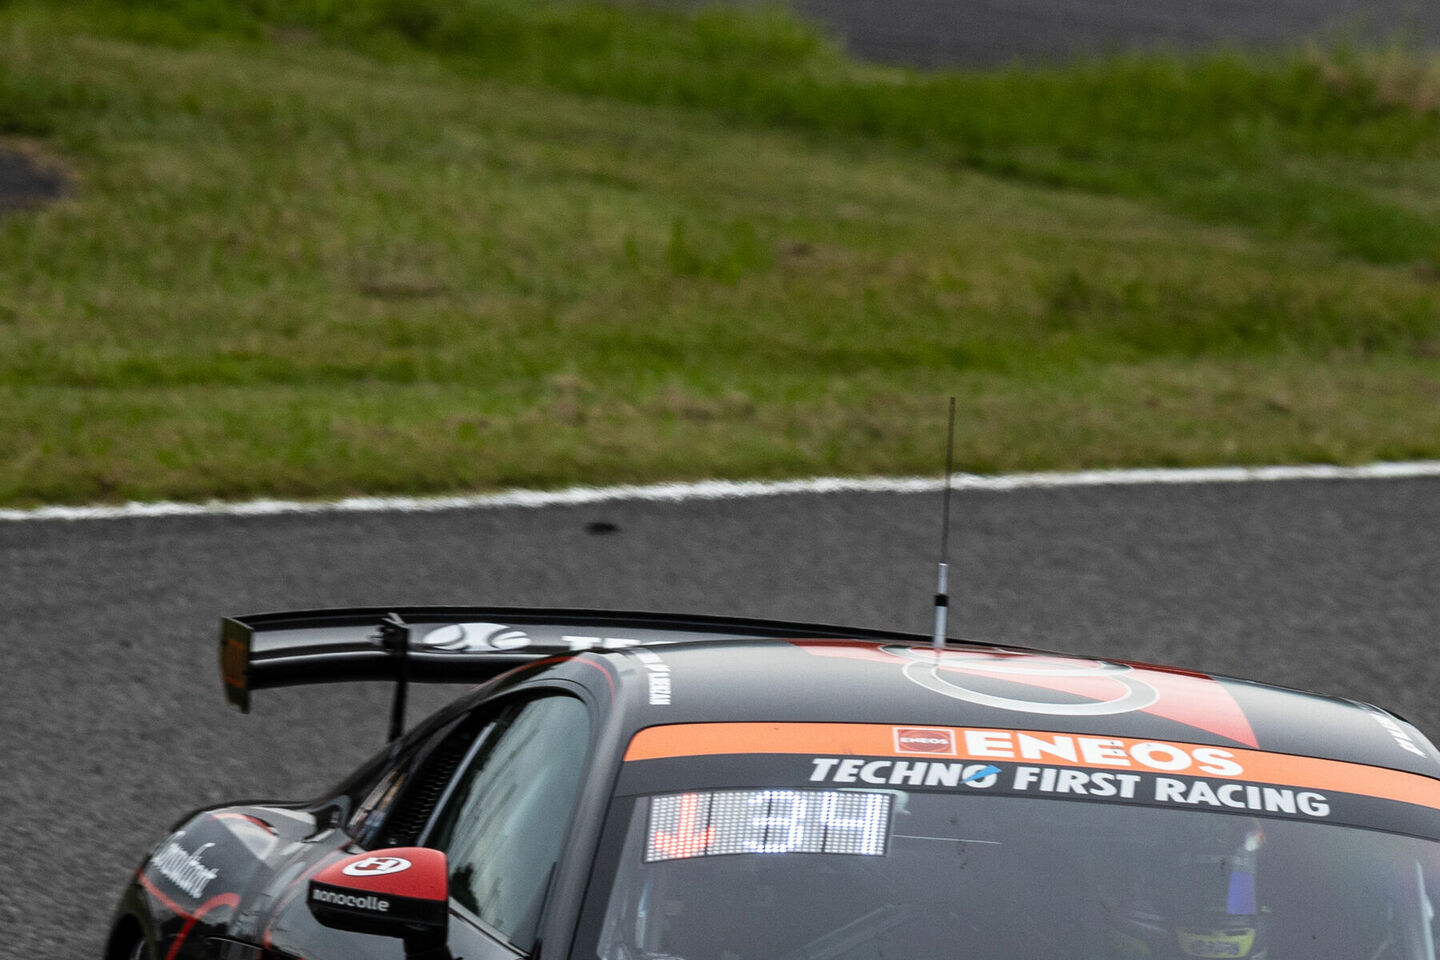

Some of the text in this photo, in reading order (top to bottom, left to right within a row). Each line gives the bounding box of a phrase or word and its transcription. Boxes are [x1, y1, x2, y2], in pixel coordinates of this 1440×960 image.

[964, 730, 1244, 777] ENEOS
[810, 757, 1331, 818] TECHNO FIRST RACING
